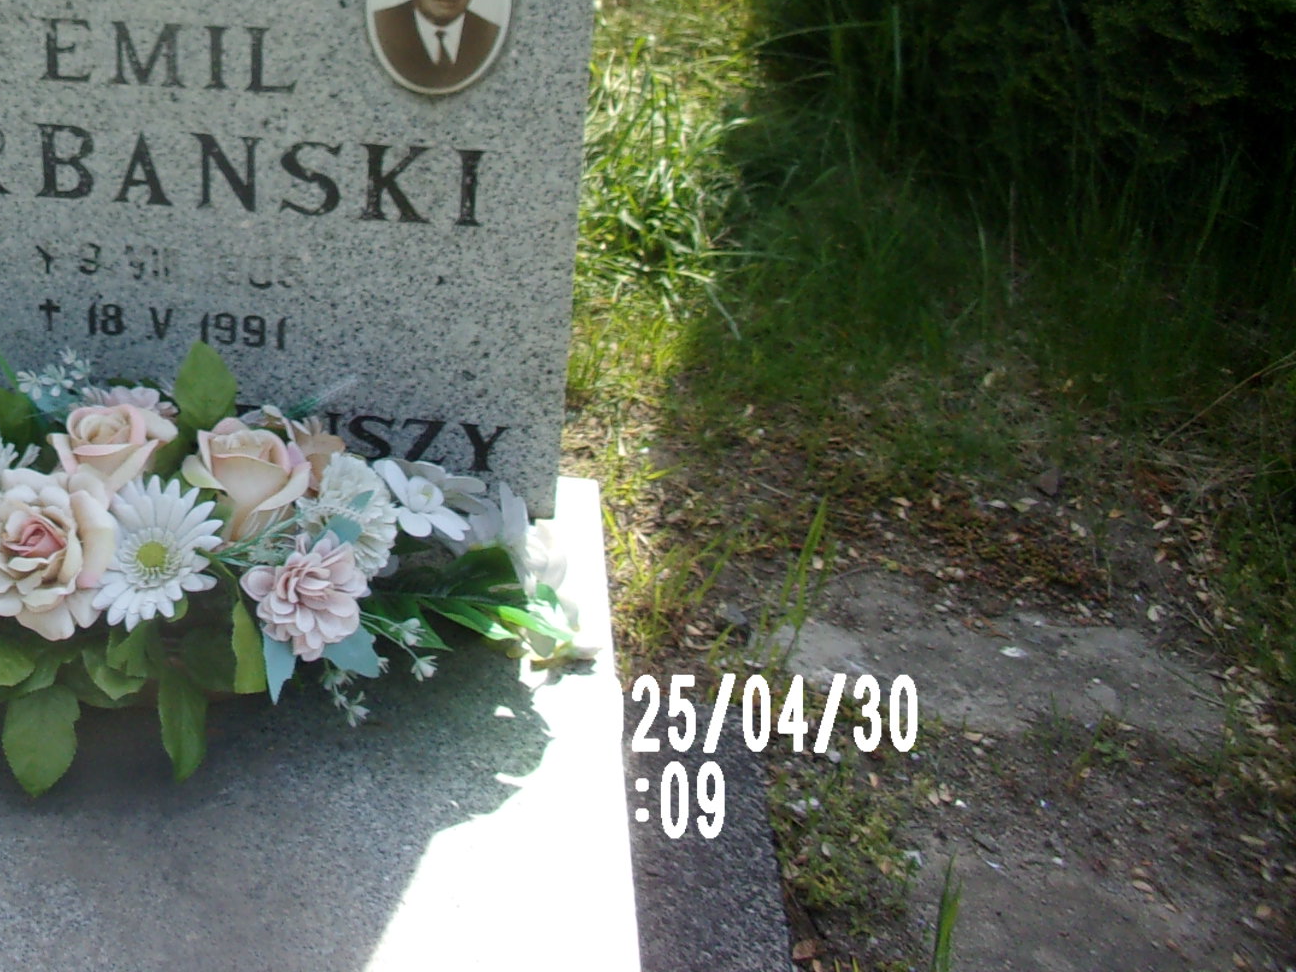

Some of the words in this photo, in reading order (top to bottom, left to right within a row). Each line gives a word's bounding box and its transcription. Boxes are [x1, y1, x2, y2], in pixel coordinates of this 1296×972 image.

[37, 17, 298, 95] EMIL
[86, 303, 128, 336] 18
[149, 306, 174, 341] V
[200, 312, 288, 350] 1991
